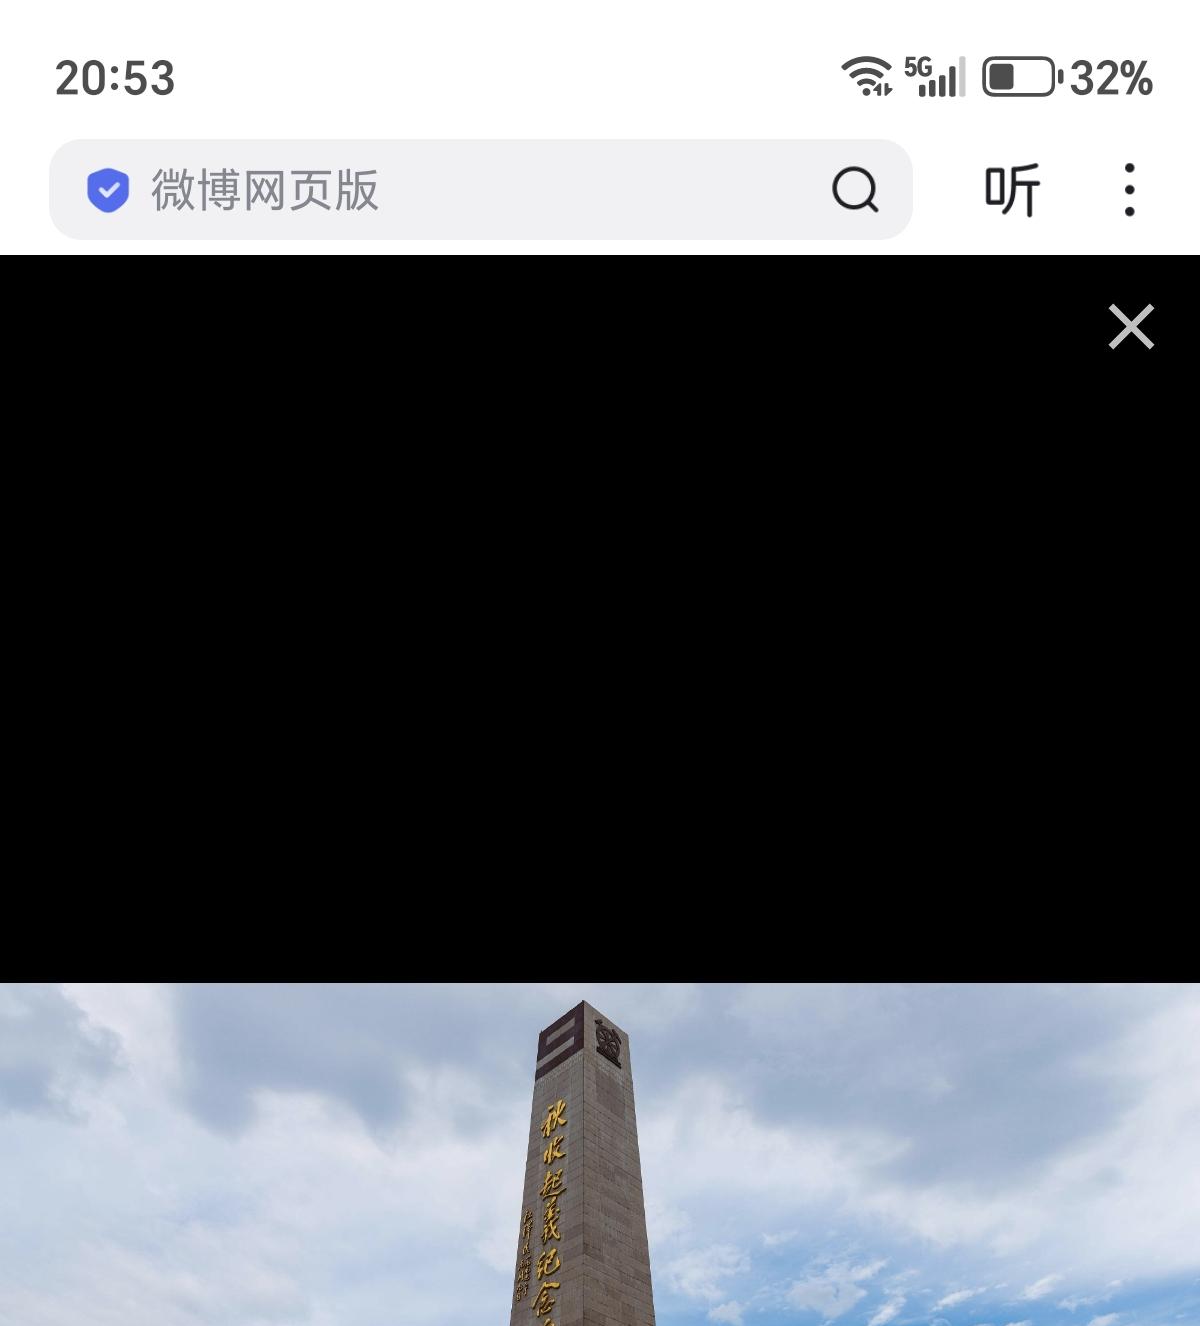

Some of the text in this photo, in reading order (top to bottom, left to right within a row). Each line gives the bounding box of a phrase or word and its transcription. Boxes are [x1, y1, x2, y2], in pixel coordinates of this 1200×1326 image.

[56, 60, 174, 95] 20:53
[904, 56, 933, 77] 5G
[1071, 60, 1153, 96] 32%
[151, 168, 379, 212] 微博网页版
[985, 163, 1041, 218] 听
